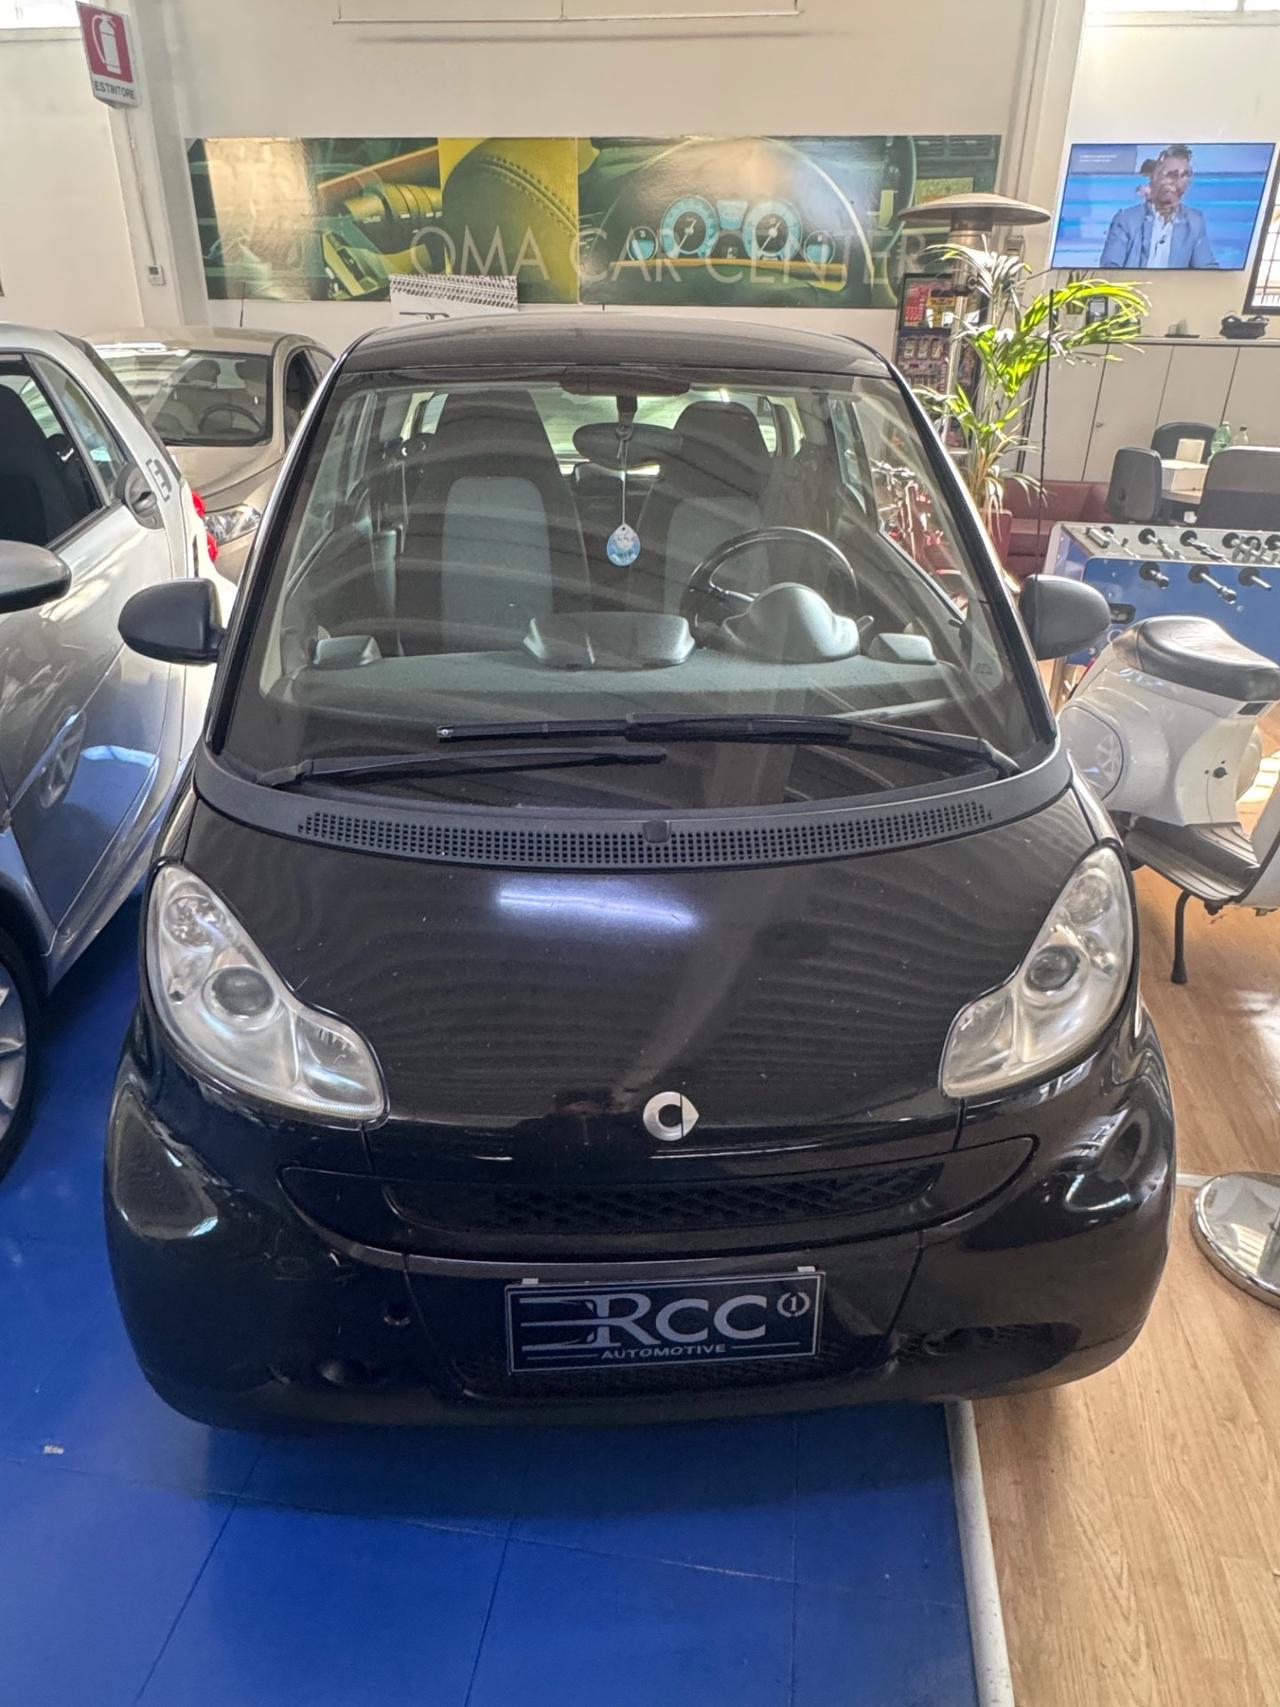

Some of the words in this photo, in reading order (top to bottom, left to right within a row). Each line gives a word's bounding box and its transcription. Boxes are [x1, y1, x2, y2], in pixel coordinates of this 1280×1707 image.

[95, 81, 135, 99] ESTINTORE
[570, 226, 683, 283] CAR
[600, 1343, 727, 1360] AUTOMOTIVE
